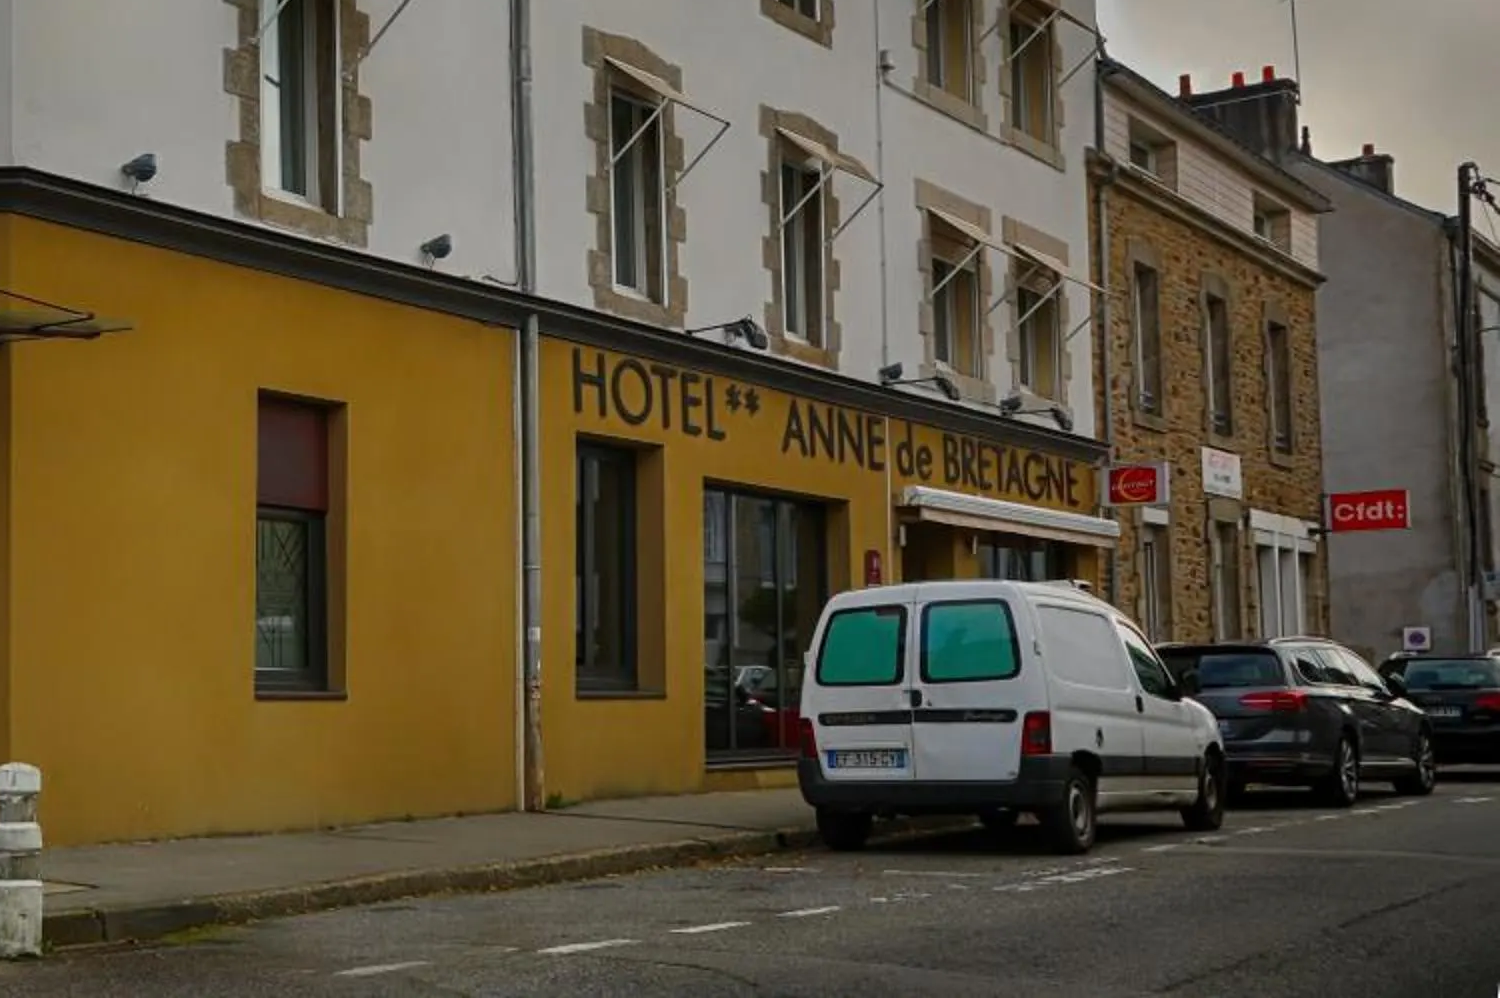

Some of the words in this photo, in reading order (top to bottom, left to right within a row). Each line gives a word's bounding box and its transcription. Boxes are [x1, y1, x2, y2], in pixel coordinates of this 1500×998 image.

[782, 398, 885, 472] ANNE
[896, 420, 933, 481] de
[943, 432, 1081, 507] BRETAGNE
